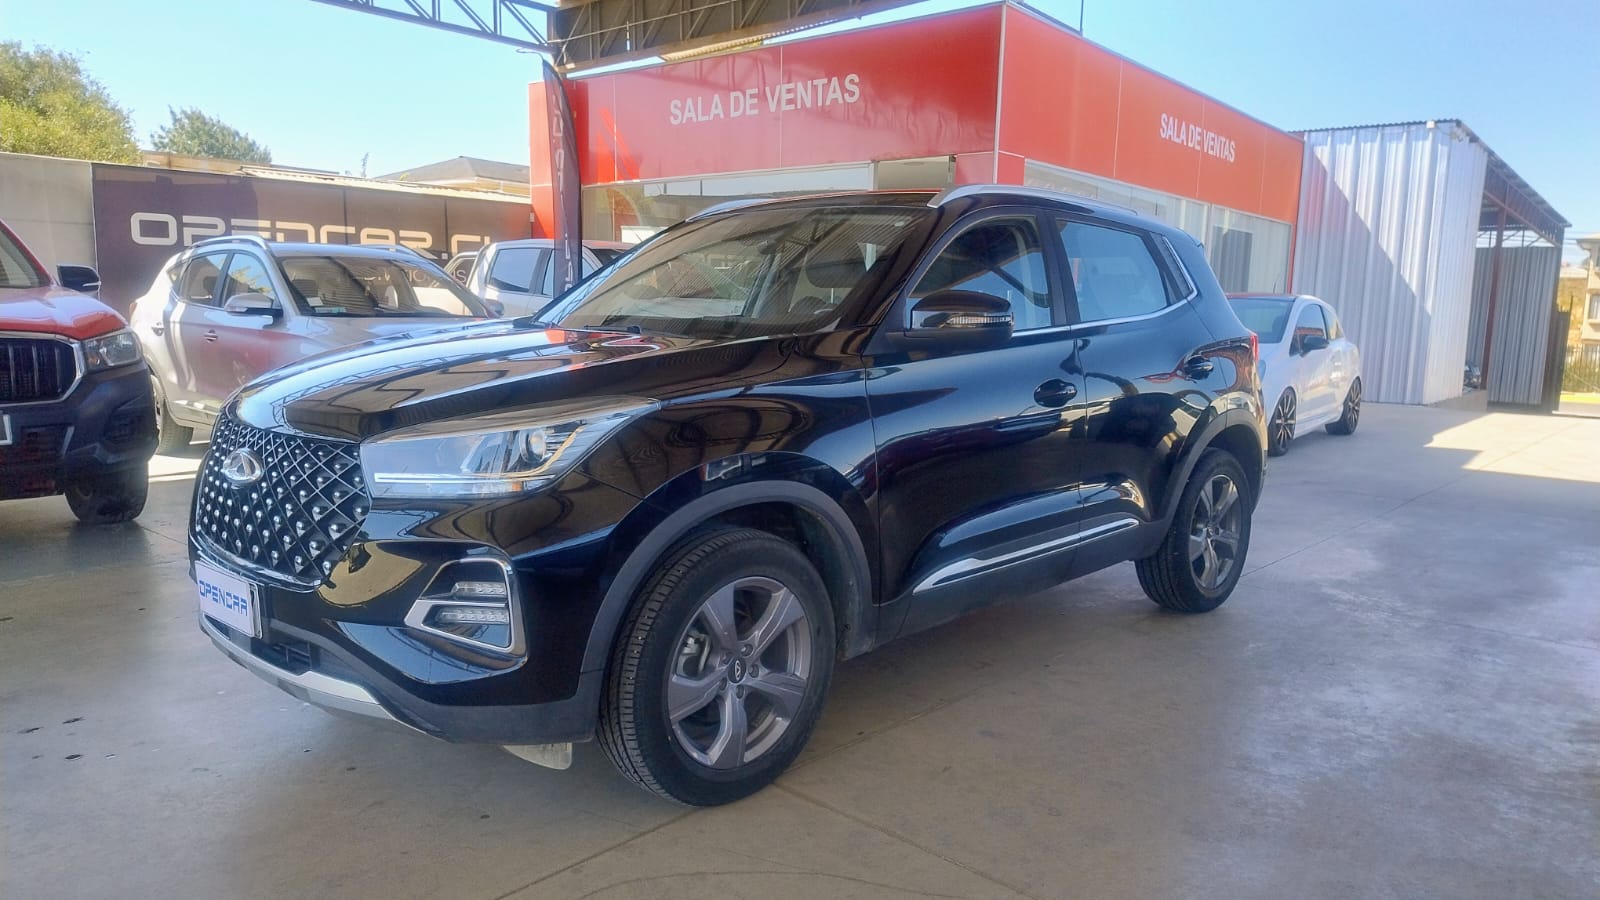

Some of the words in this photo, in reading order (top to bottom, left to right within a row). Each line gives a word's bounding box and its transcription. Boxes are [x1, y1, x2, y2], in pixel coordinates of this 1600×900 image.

[670, 96, 725, 125] SALA
[730, 88, 759, 118] DE
[765, 73, 860, 113] VENTAS
[1160, 112, 1187, 146] SALA
[1188, 123, 1202, 151] DE
[1203, 128, 1236, 163] VENTAS
[199, 580, 248, 616] OPENCAR
